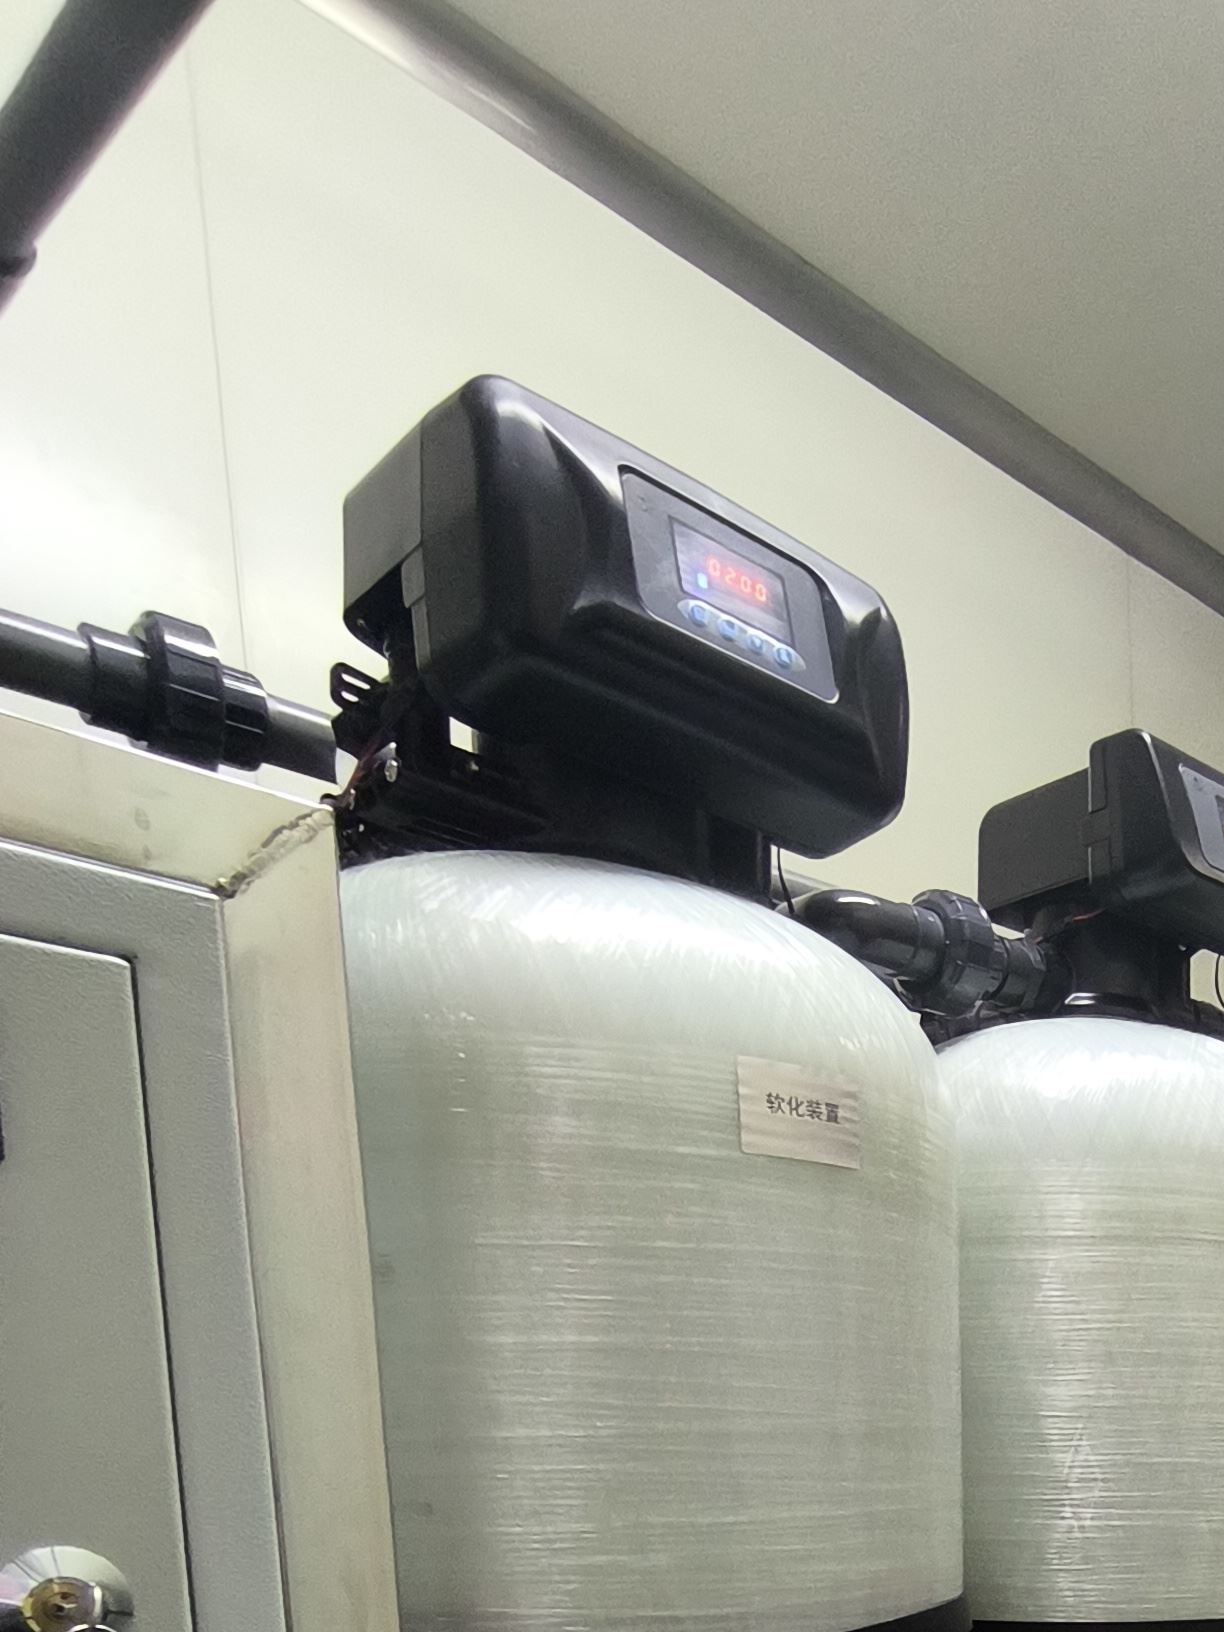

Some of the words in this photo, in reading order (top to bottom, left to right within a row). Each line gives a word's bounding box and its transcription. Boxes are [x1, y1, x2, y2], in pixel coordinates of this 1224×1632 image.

[708, 558, 767, 602] 0200
[766, 1091, 840, 1124] 软化装置
